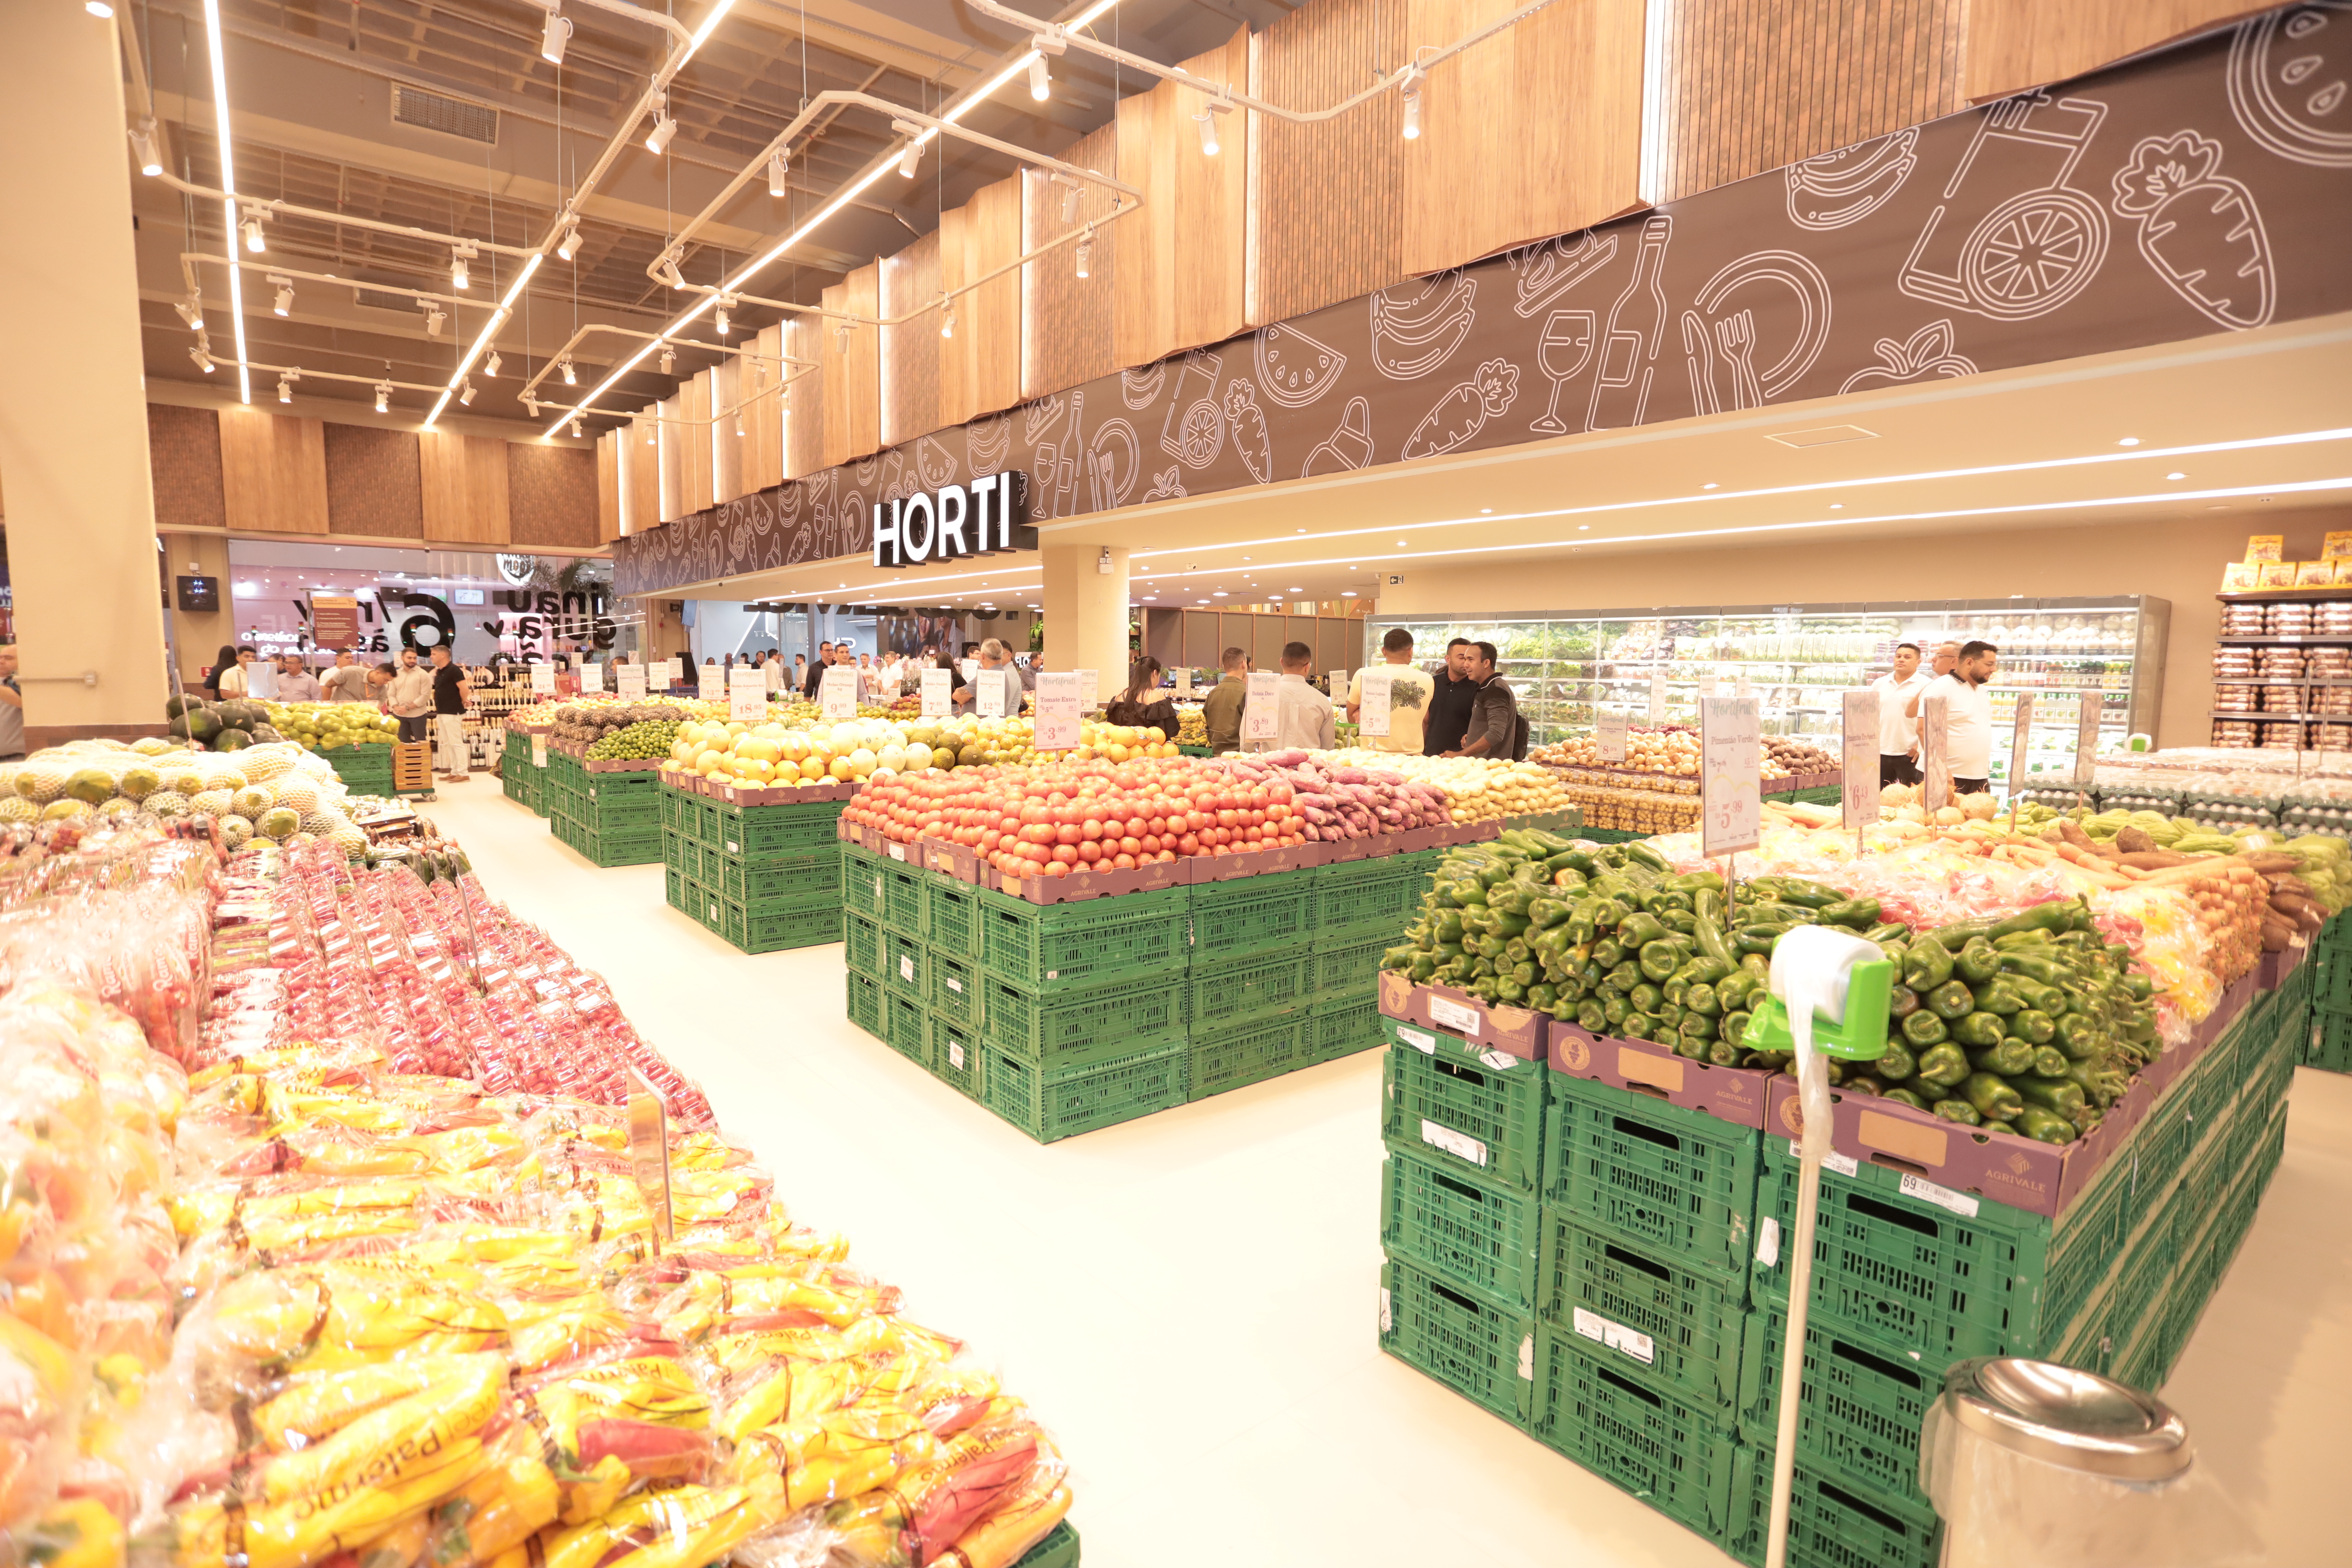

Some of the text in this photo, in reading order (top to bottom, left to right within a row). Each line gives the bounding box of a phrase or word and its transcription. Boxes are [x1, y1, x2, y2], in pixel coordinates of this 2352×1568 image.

[874, 471, 1009, 567] HORTI
[1041, 677, 1076, 687] Hortifruti
[1251, 675, 1276, 684] Hortifruti
[1364, 677, 1387, 686] Hortifruti
[739, 704, 761, 714] 18,95
[830, 703, 847, 713] 9,99
[929, 701, 942, 711] 7,49
[983, 701, 1000, 710] 12,69
[1253, 717, 1268, 732] 3,89
[1369, 717, 1381, 728] 5,99
[1048, 726, 1066, 740] 3,99
[1711, 734, 1753, 745] Pimentão Verde
[1603, 745, 1617, 754] 8,99
[1853, 785, 1868, 810] 6,19
[1721, 800, 1742, 829] 5,99
[1146, 878, 1169, 886] AGRIVALE
[1398, 1027, 1405, 1038] 63
[1496, 1029, 1528, 1043] AGRIVALE
[1715, 1090, 1753, 1105] AGRIVALE
[1903, 1175, 1917, 1190] 69
[1984, 1169, 2046, 1193] AGRIVALE
[921, 1444, 995, 1482] Palermo
[294, 1430, 442, 1521] Palermo
